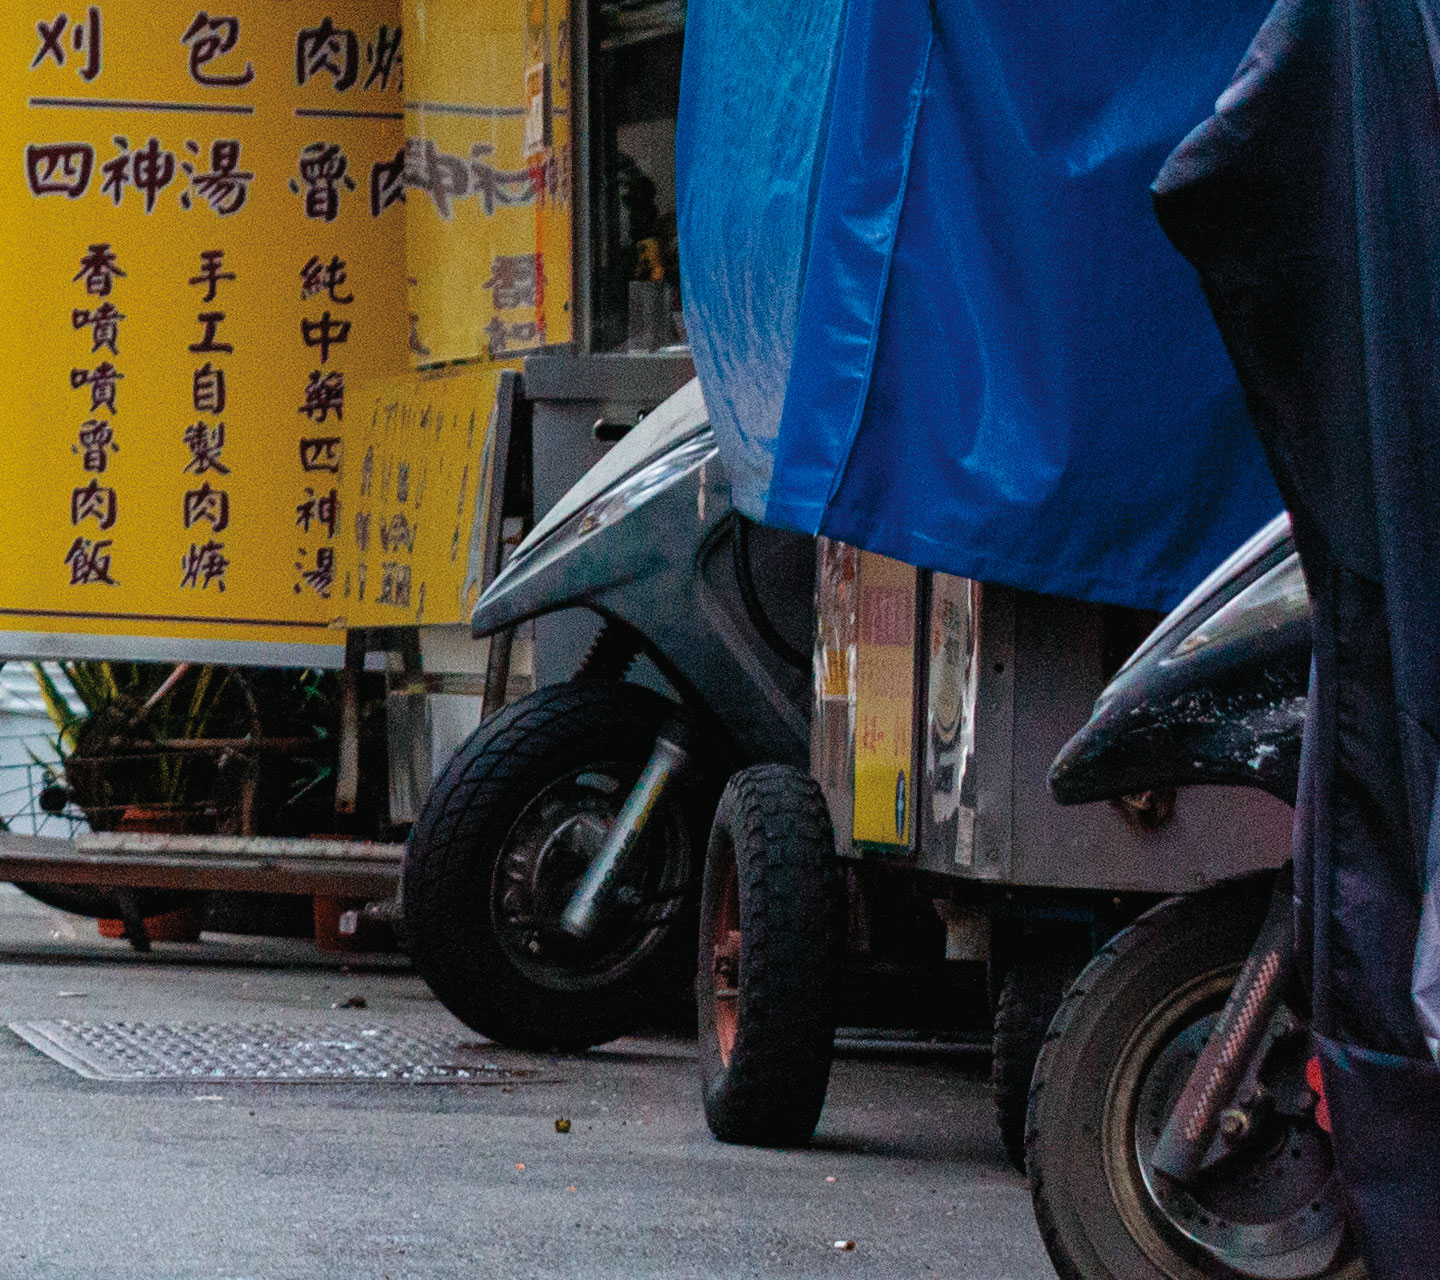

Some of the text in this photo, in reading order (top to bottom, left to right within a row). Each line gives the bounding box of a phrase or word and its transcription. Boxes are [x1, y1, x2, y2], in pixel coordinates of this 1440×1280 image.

[30, 5, 254, 88] 刈包
[25, 138, 253, 217] 四神湯
[63, 243, 127, 589] 香噴噴魯肉飯
